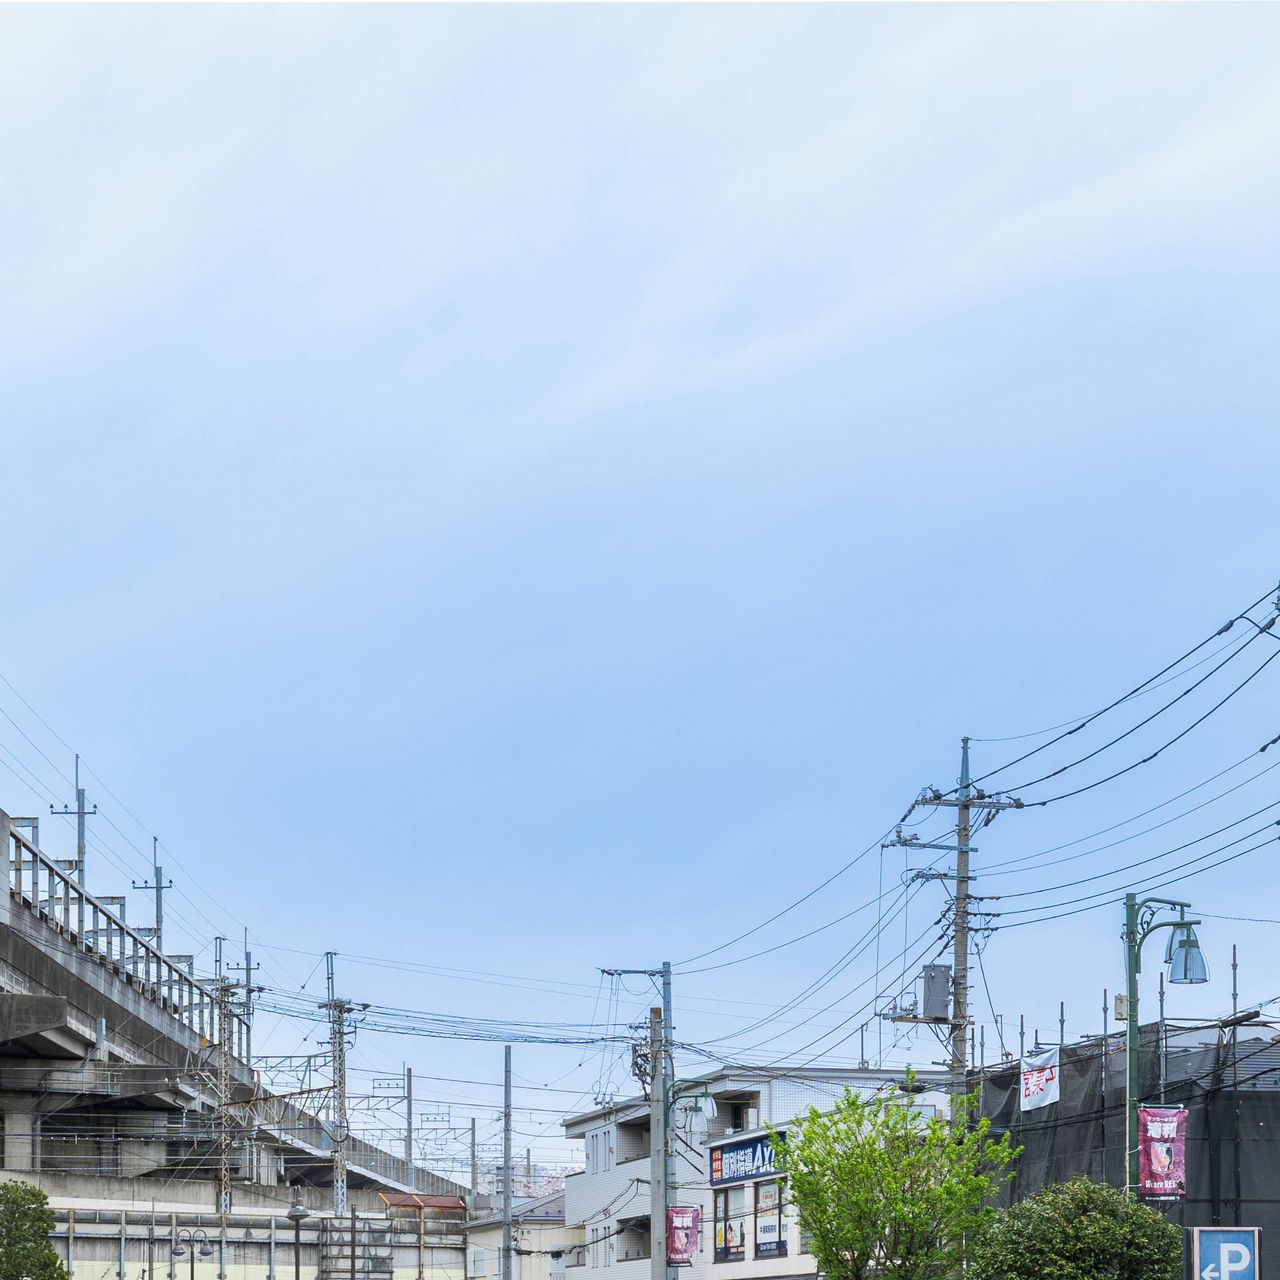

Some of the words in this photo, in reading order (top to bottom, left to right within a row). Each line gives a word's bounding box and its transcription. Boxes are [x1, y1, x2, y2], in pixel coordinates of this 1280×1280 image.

[1147, 1122, 1178, 1138] 浦和
[722, 1147, 753, 1179] 個別指導
